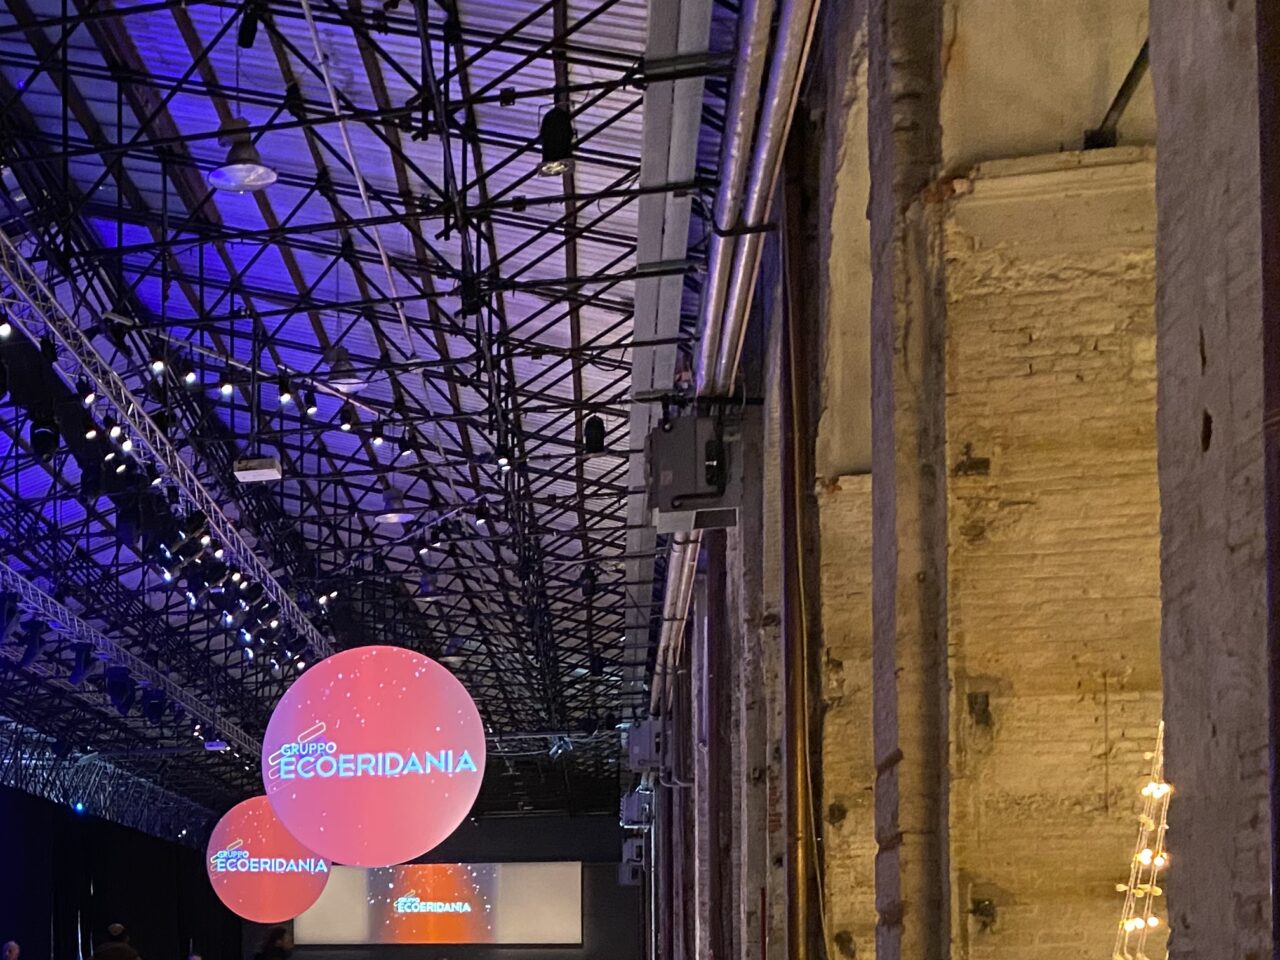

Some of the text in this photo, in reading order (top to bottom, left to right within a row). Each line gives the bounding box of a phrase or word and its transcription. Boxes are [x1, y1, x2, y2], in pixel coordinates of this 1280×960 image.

[281, 741, 337, 756] GRUPPO
[280, 749, 478, 780] ECOERIDANIA
[217, 850, 249, 859] GRUPPO
[216, 858, 328, 872] ECOERIDANIA
[397, 901, 472, 913] ECOERIDANIA
